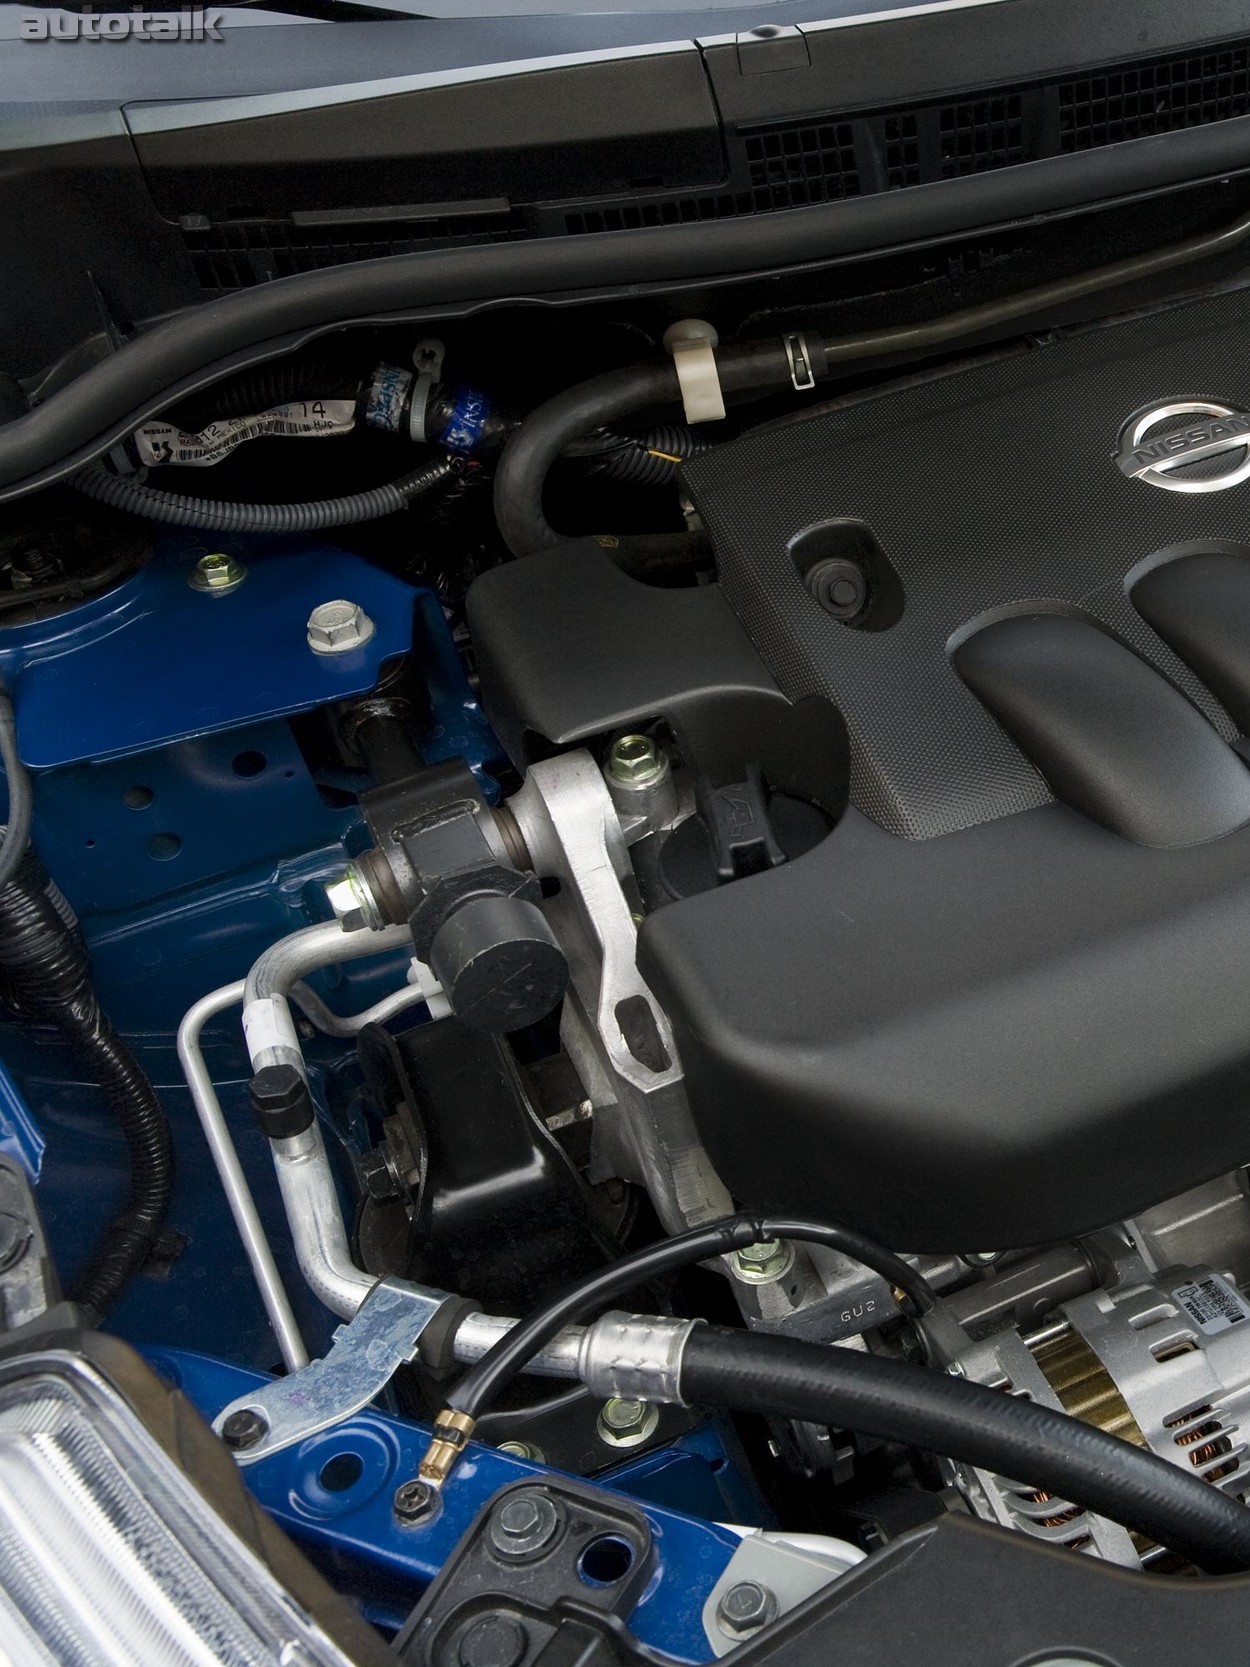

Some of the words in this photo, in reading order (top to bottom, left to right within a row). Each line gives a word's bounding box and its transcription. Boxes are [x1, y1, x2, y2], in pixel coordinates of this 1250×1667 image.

[1131, 415, 1249, 465] NISSAN
[840, 1300, 876, 1322] GU2
[1184, 1301, 1208, 1325] NISSAN
